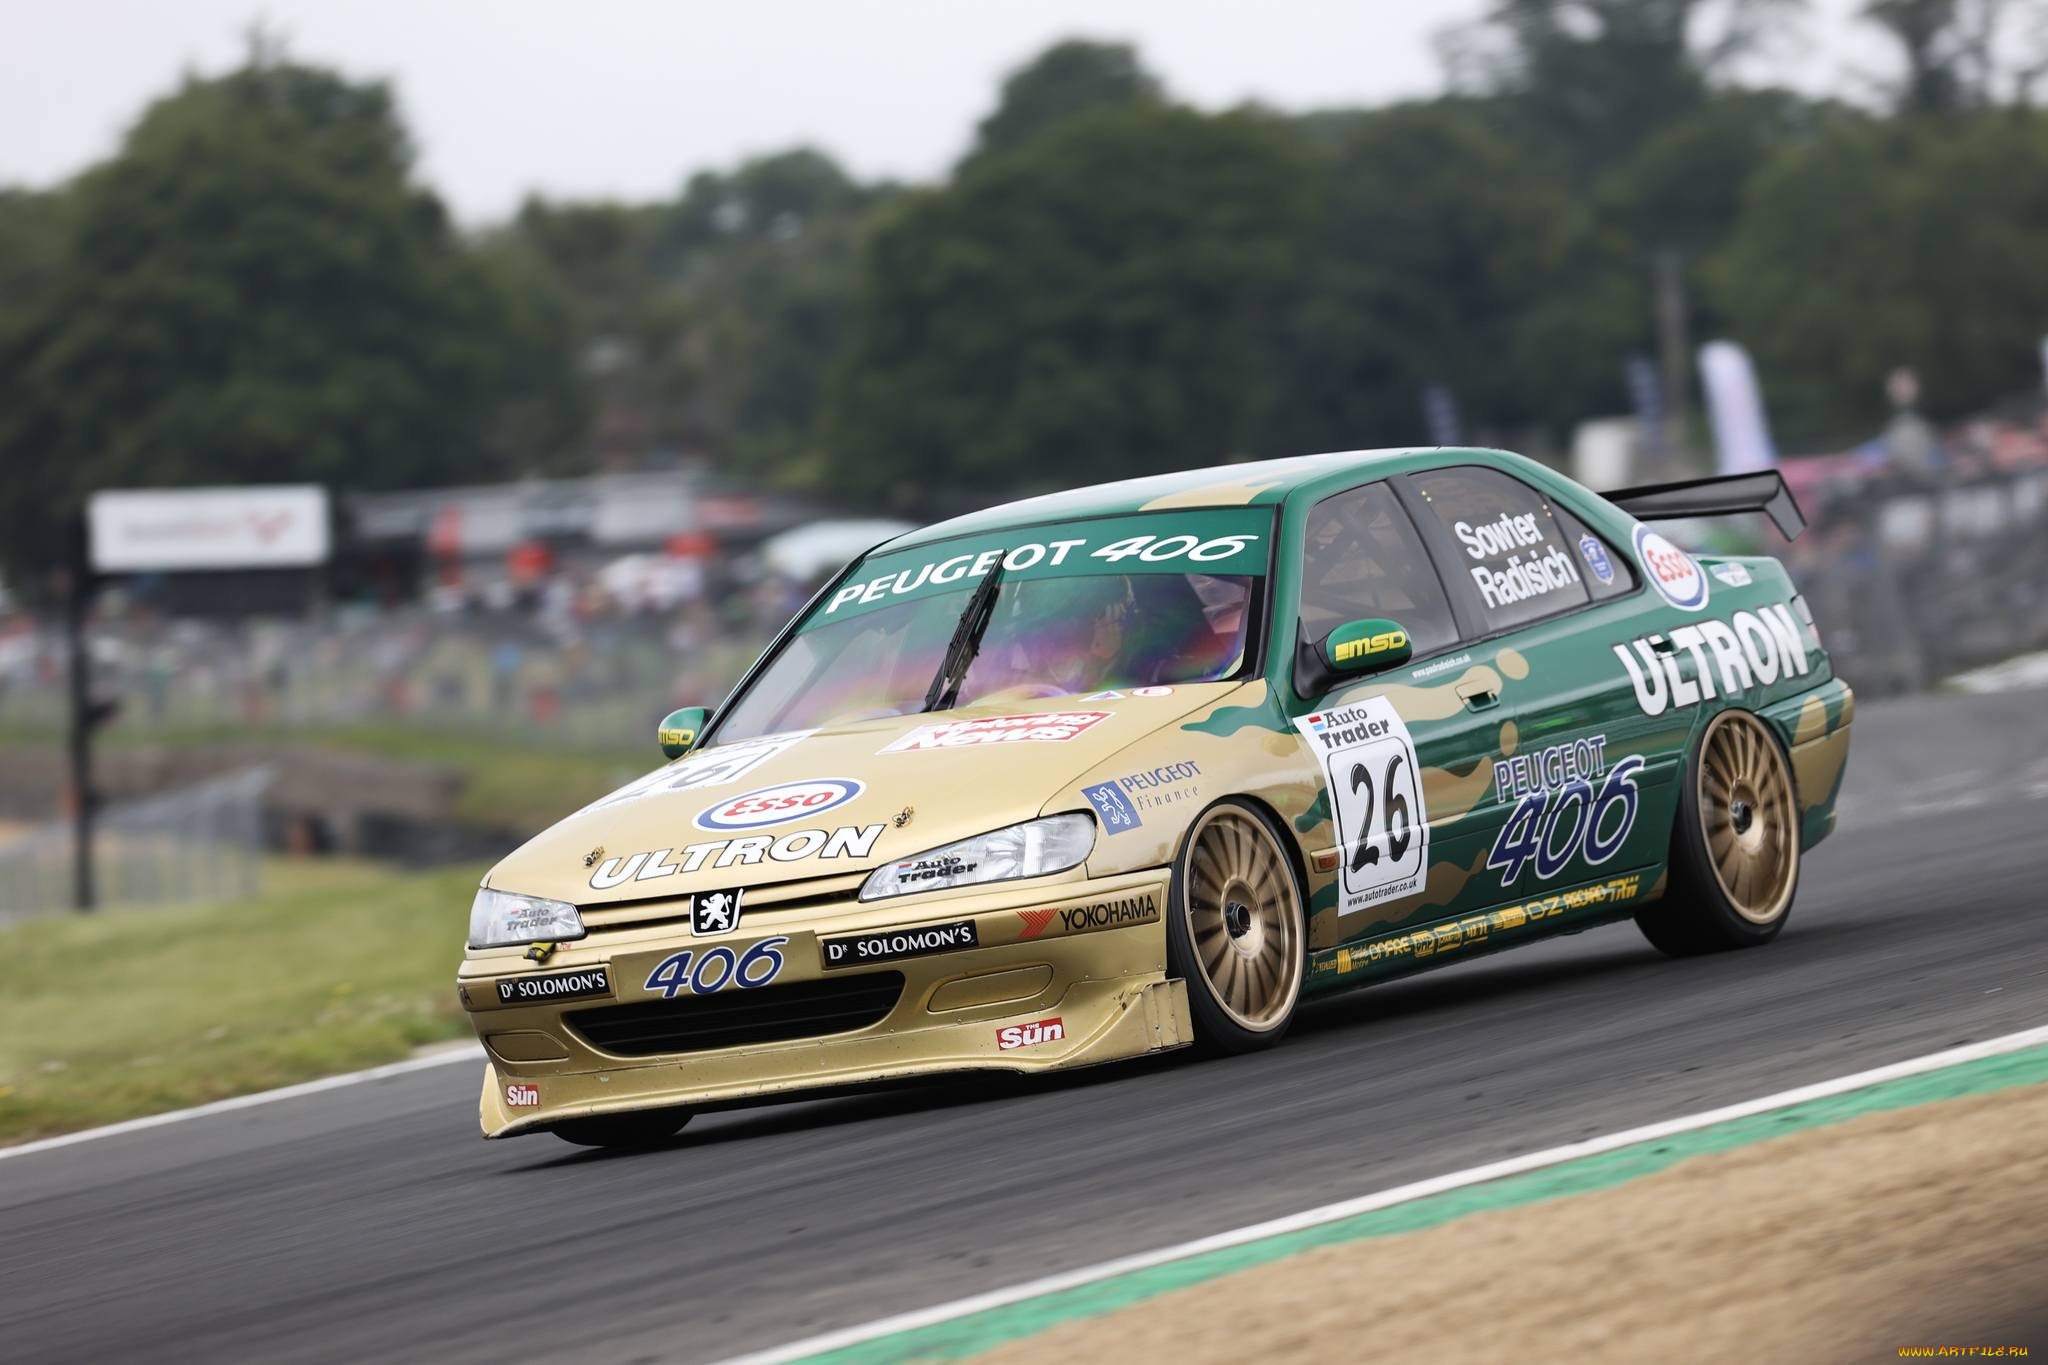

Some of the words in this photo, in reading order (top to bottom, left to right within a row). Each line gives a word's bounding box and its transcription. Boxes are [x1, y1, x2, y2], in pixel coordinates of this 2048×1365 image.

[1454, 512, 1545, 560] Sowter
[824, 538, 1087, 615] PEUGEOT
[1091, 534, 1259, 562] 406
[1470, 544, 1580, 609] Radisich
[1612, 602, 1810, 717] ULTRON
[1319, 718, 1390, 749] Trader
[1323, 707, 1369, 729] Auto
[1119, 761, 1201, 793] PEUGEOT
[1494, 734, 1607, 804] PEUGEOT
[1137, 785, 1199, 811] Finance
[1350, 754, 1411, 874] 26
[1486, 754, 1646, 888] 406
[589, 823, 887, 891] ULTRON
[898, 862, 977, 884] Trader
[913, 856, 961, 871] Auto
[1346, 877, 1418, 908] www.autotrader.co.uk
[507, 915, 558, 932] Trader
[519, 908, 550, 919] Auto
[1058, 894, 1157, 931] YOKOHAMA
[857, 926, 973, 958] SOLOMON'S
[643, 935, 790, 999] 406
[518, 972, 606, 997] SOLOMON'S
[1000, 1023, 1063, 1050] Sun
[507, 1085, 538, 1106] Sun
